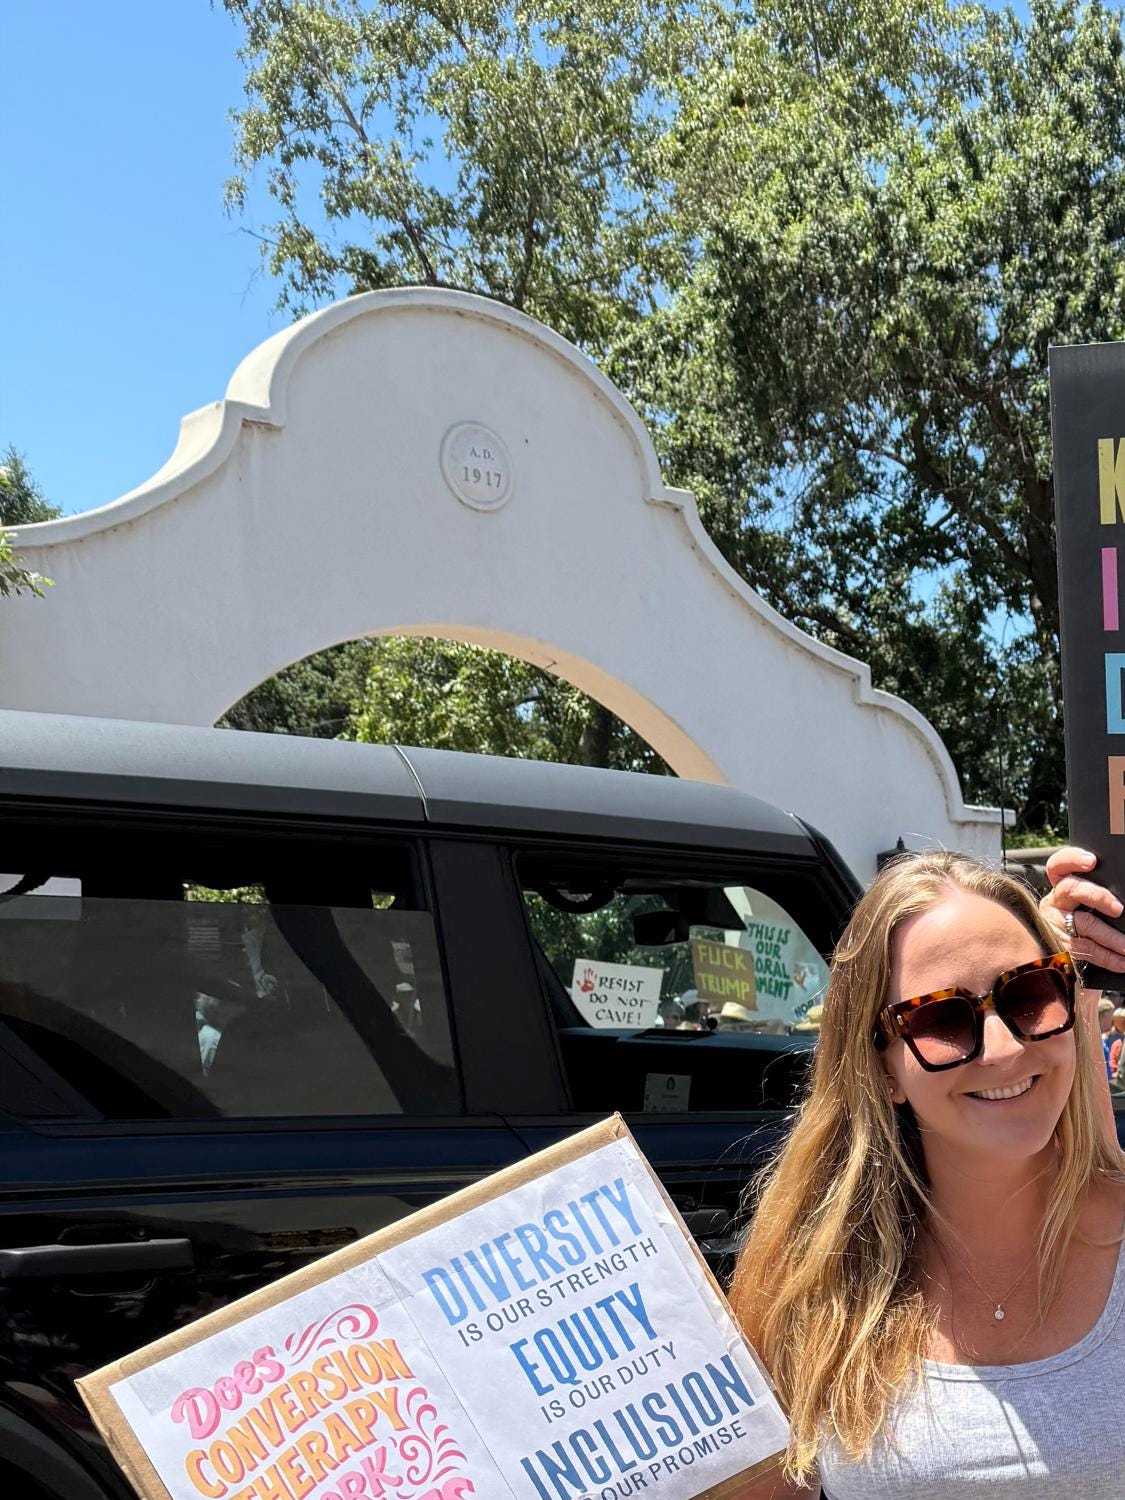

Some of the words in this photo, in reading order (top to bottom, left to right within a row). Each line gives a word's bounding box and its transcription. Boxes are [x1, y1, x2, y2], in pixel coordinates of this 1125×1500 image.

[464, 466, 501, 488] 1917
[747, 922, 776, 941] THIS
[778, 928, 791, 945] IS
[697, 945, 747, 971] FUCK
[756, 940, 781, 960] OUR
[755, 958, 791, 979] ORAL
[599, 976, 645, 992] RESIST
[697, 973, 750, 1000] TRUMP
[755, 976, 793, 1001] MENT
[589, 993, 608, 1004] DO
[617, 996, 649, 1008] NOT
[595, 1009, 641, 1025] CAVE!
[420, 1177, 643, 1326] DIVERSITY
[457, 1323, 483, 1347] IS
[486, 1298, 534, 1332] OUR
[536, 1237, 658, 1308] STRENGTH
[509, 1282, 658, 1397] EQUITY
[541, 1400, 566, 1424] IS
[568, 1374, 616, 1409] OUR
[617, 1341, 678, 1385] DUTY
[184, 1338, 416, 1499] CONVERSION
[648, 1420, 747, 1482] PROMISE
